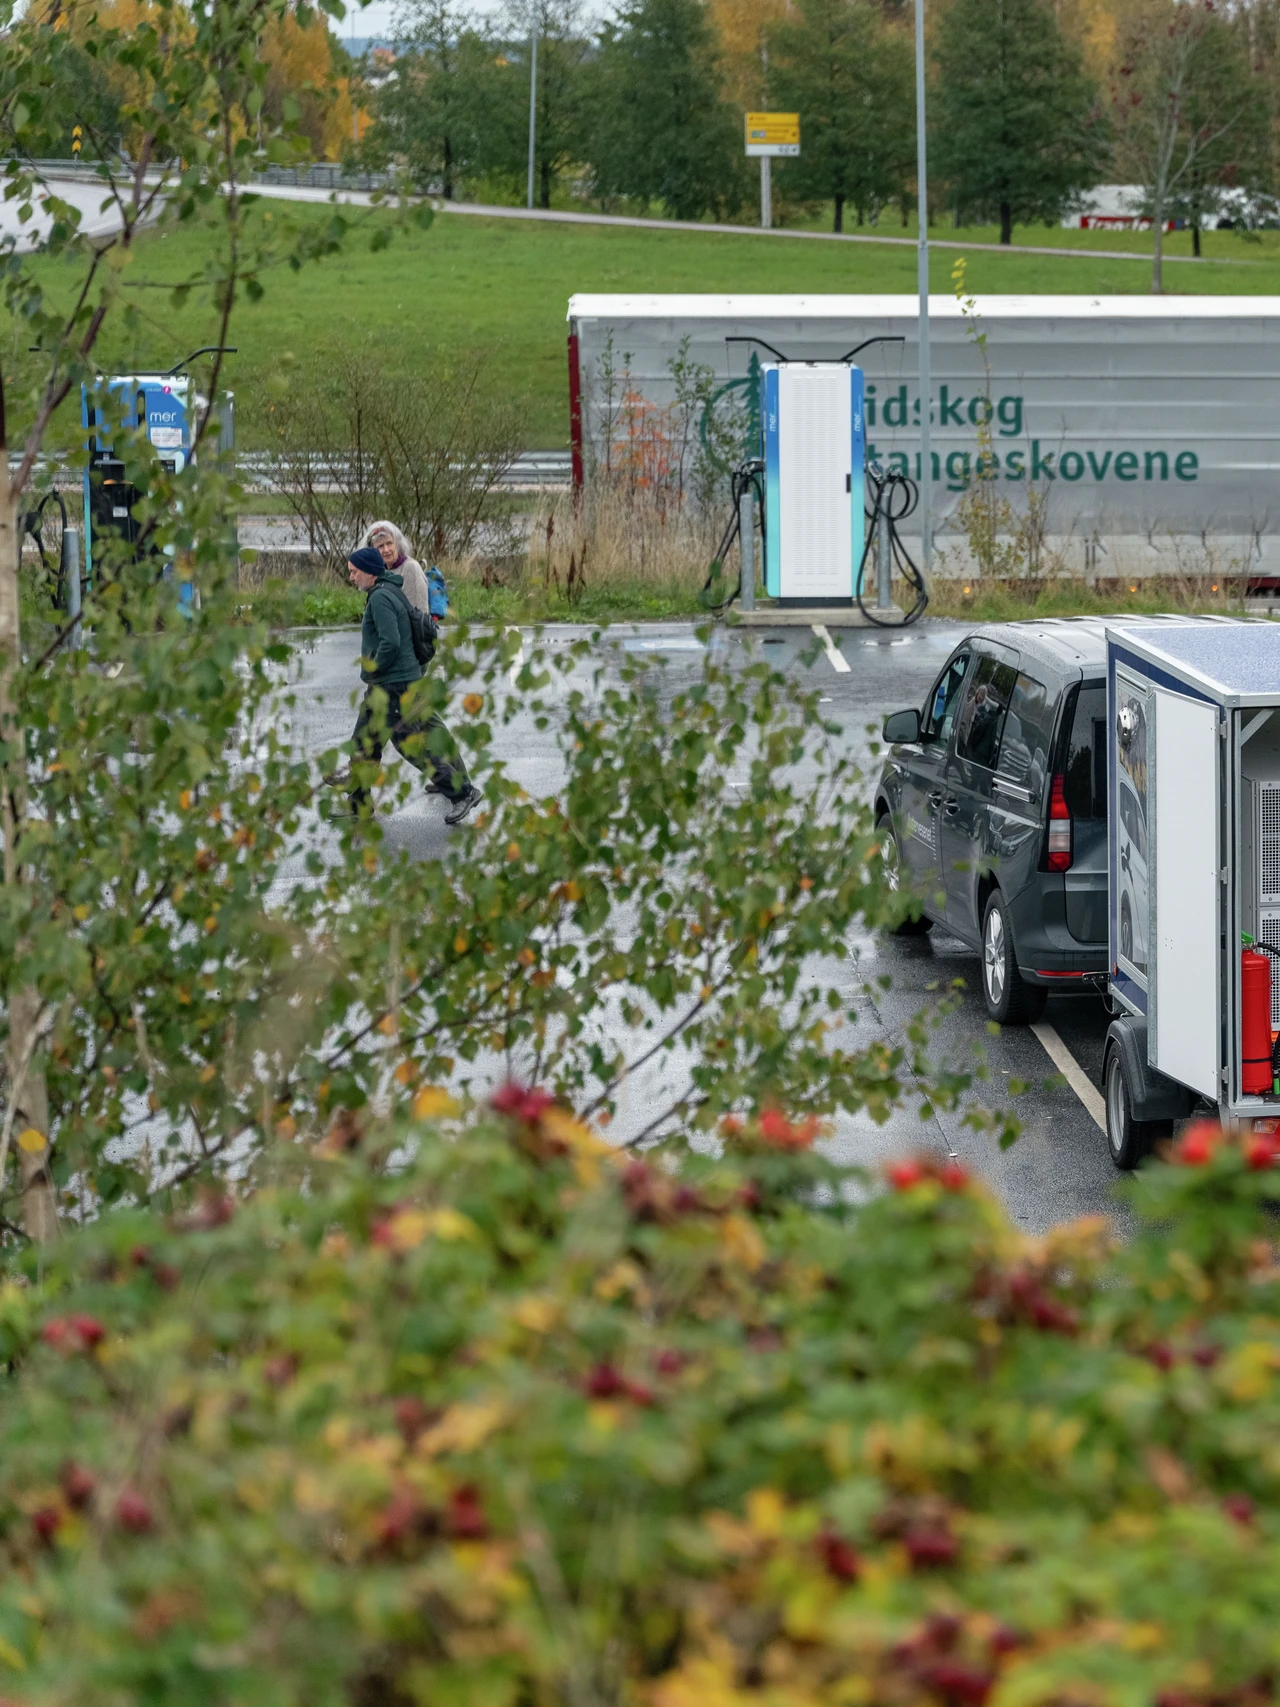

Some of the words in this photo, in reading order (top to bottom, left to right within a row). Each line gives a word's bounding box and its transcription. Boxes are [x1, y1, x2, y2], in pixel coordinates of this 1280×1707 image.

[150, 411, 177, 423] mer
[864, 384, 1024, 437] idskog
[867, 440, 1198, 492] tangeskovene
